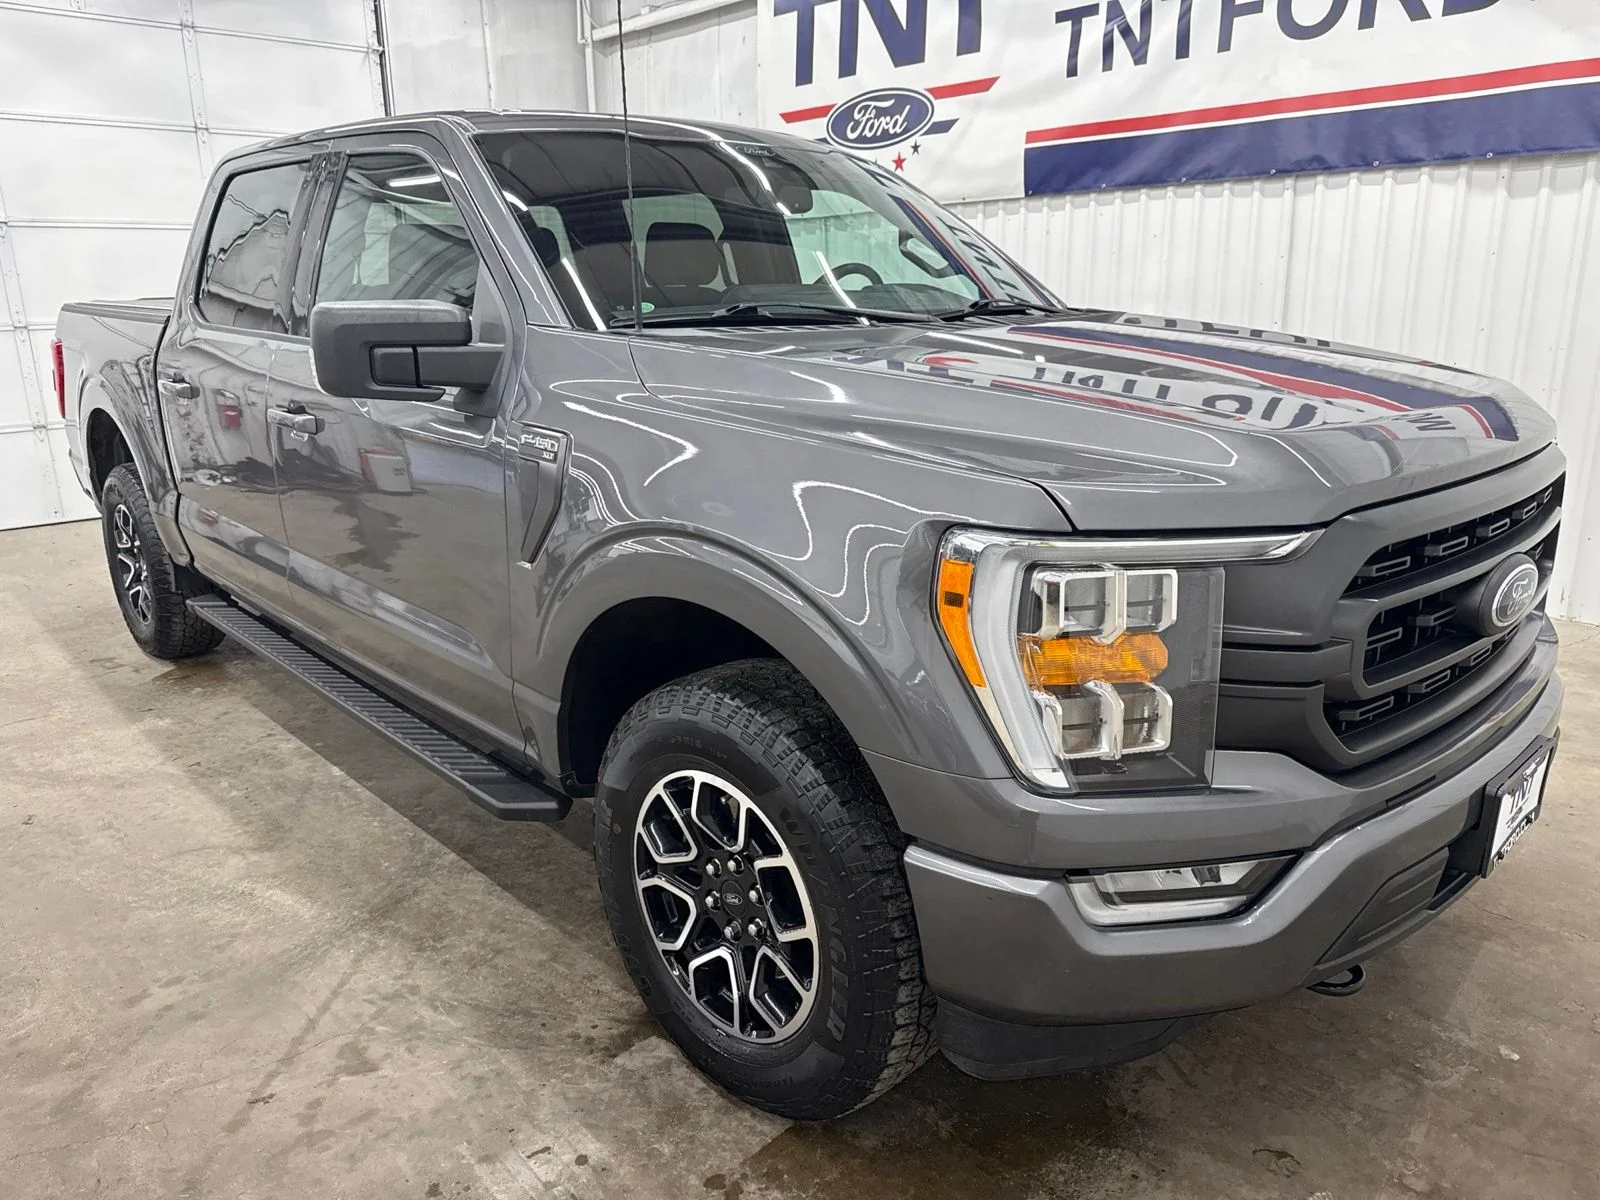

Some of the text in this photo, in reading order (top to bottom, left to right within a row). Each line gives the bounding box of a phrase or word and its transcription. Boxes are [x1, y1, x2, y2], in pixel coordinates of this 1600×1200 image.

[1055, 0, 1500, 78] TNTFO
[846, 99, 911, 139] Ford
[520, 434, 559, 452] F-150
